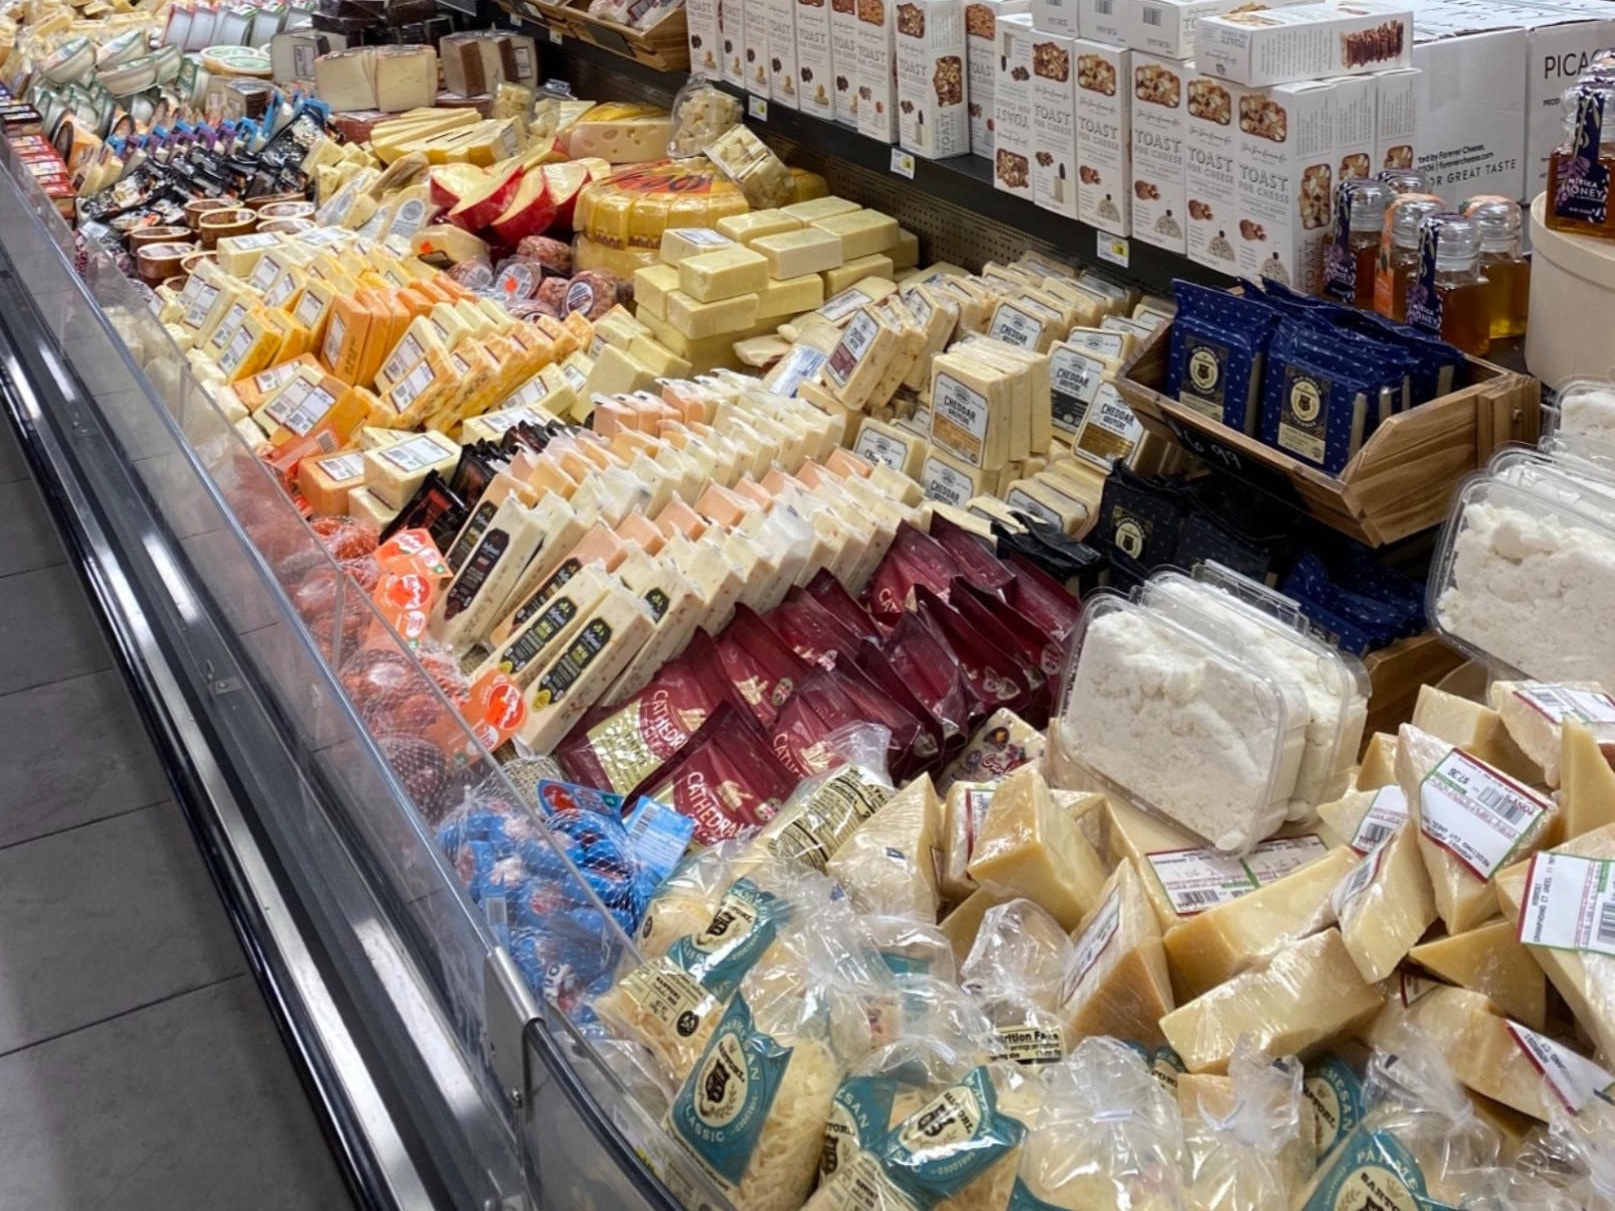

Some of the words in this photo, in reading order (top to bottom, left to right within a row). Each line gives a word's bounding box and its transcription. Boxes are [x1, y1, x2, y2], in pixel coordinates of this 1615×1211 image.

[799, 28, 826, 44] TOAST
[969, 60, 994, 77] TOAS
[1034, 103, 1071, 125] TOAST
[1079, 116, 1118, 139] TOAST
[1134, 128, 1182, 153] TOAST
[1134, 145, 1150, 155] FOR
[1152, 149, 1182, 165] CHEESE
[1187, 146, 1233, 172] TOAST
[1187, 162, 1202, 174] FOR
[1204, 168, 1234, 185] CHEESE
[1239, 163, 1288, 192] TOAST
[1447, 167, 1481, 184] GREAT
[1486, 159, 1517, 175] TASTE
[1239, 180, 1254, 193] FOR
[1257, 187, 1289, 204] CHEESE
[1562, 183, 1603, 198] HONEY
[1408, 310, 1438, 326] HONEY
[1001, 324, 1028, 346] CHEDDAR
[1056, 368, 1089, 389] CHEDDAR
[944, 395, 976, 423] CHEDDAR
[1101, 403, 1135, 427] CHEDDAR
[931, 480, 960, 505] CHEDDAR
[685, 1105, 725, 1142] CLASSIC
